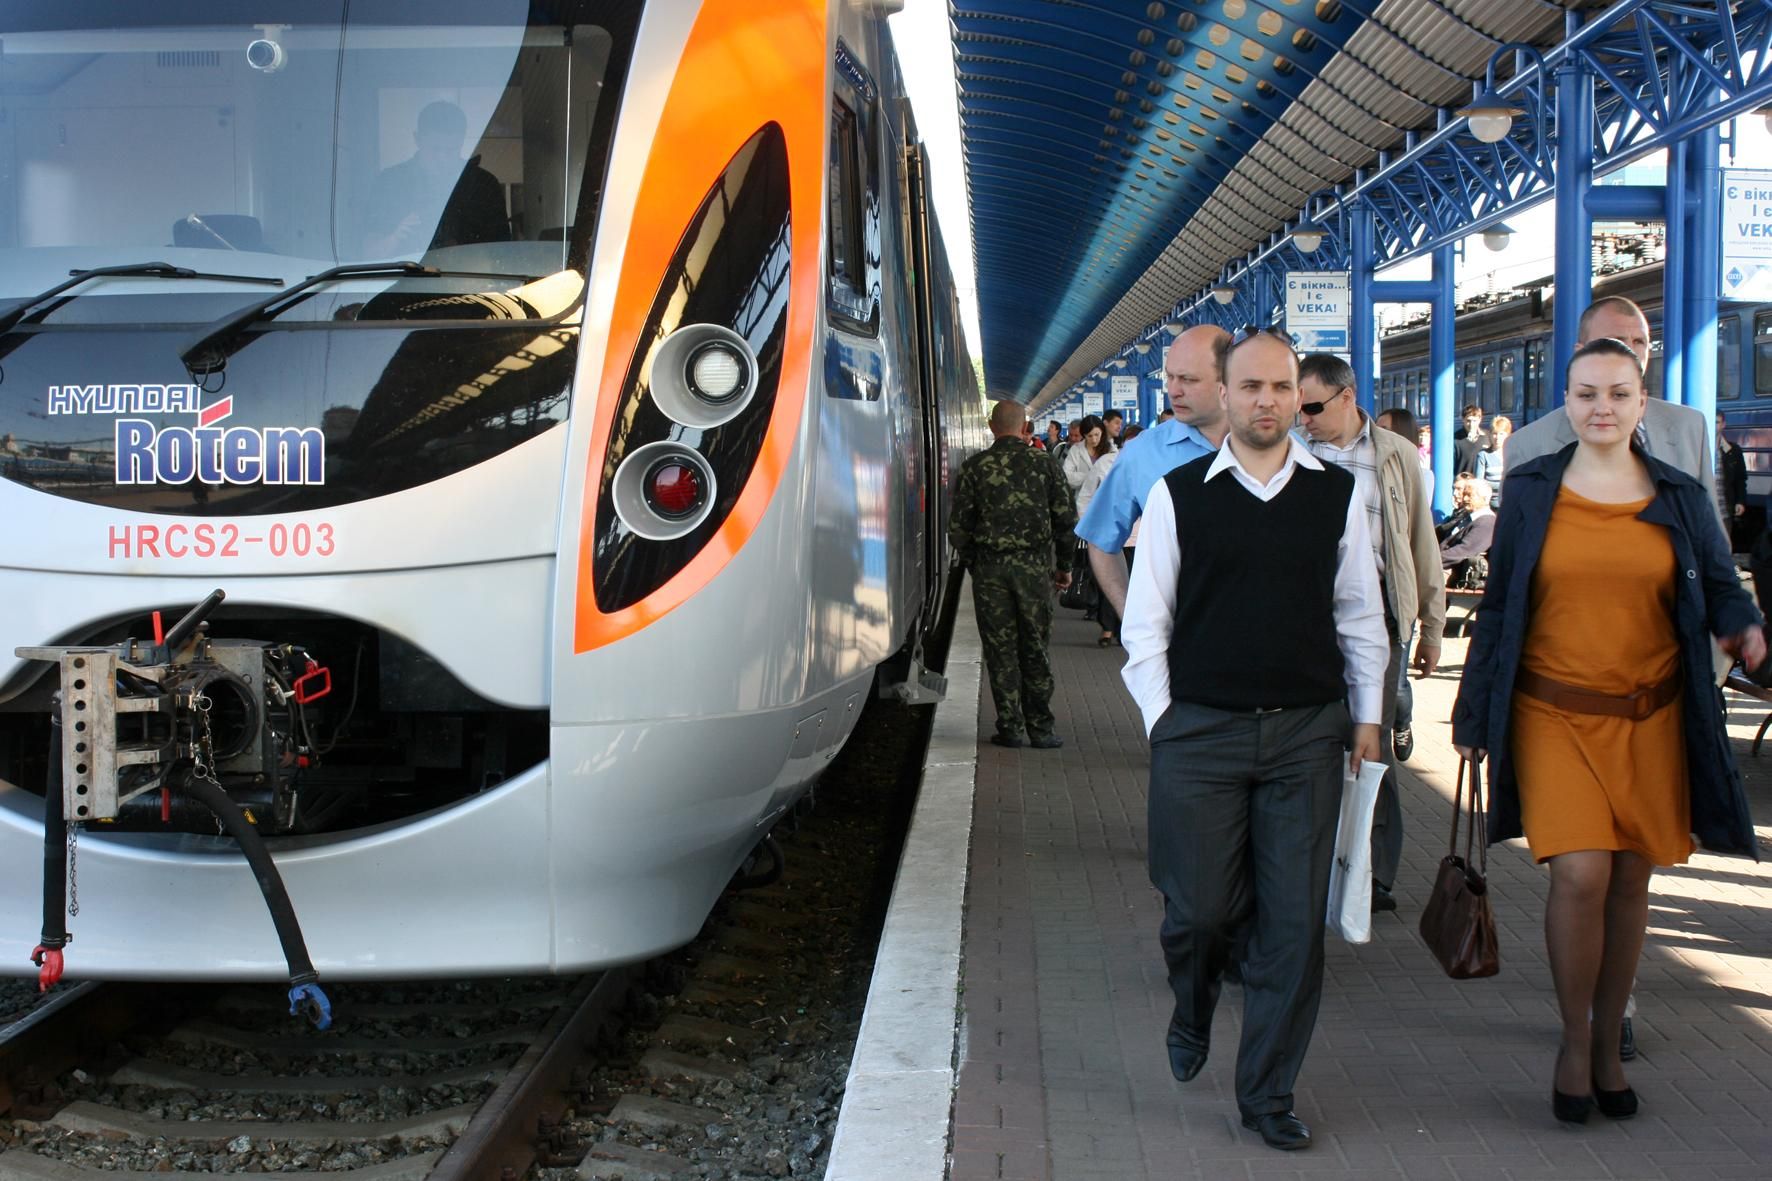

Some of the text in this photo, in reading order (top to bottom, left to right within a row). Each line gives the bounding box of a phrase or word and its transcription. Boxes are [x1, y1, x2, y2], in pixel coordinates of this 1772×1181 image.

[1297, 303, 1337, 313] VEKA!
[49, 384, 201, 415] HYUNDAI
[115, 418, 325, 486] Rotem
[108, 523, 336, 559] HRCS2-003
